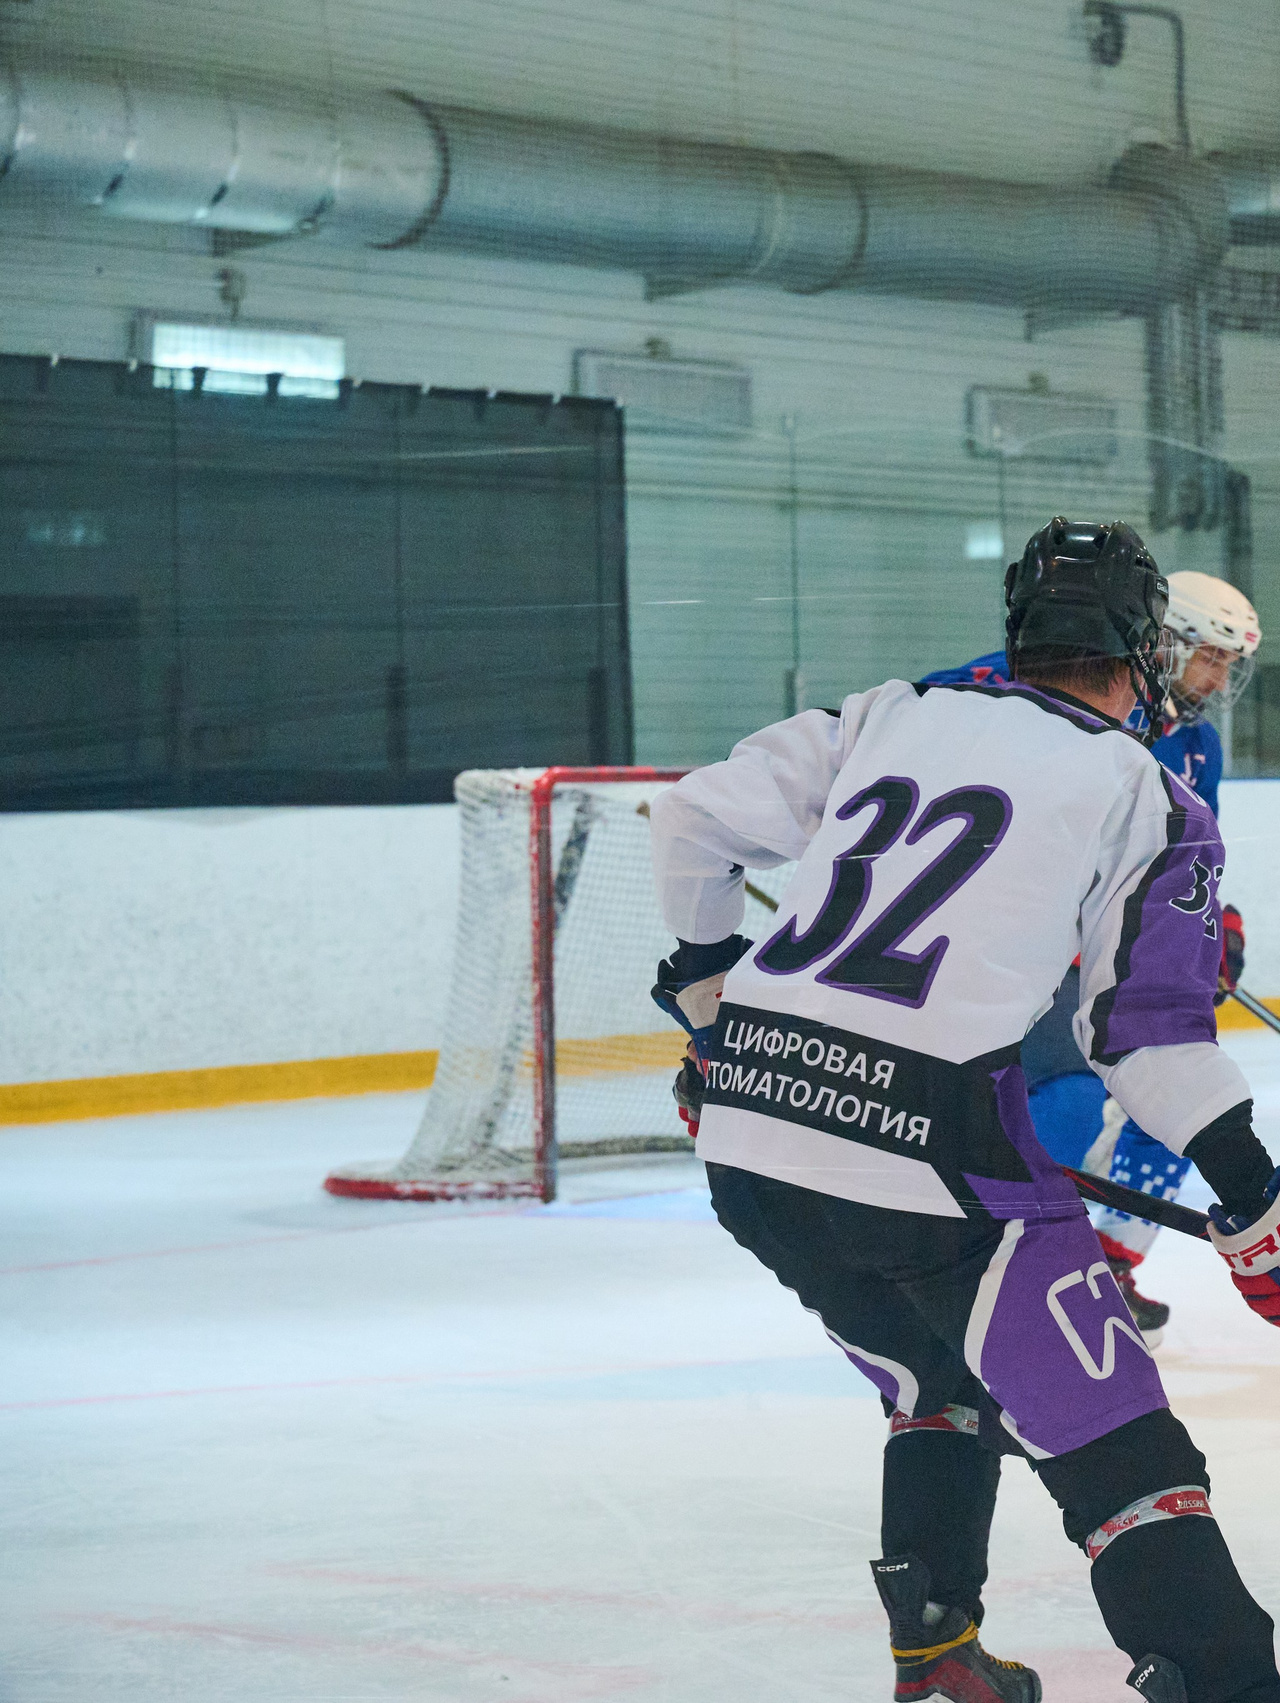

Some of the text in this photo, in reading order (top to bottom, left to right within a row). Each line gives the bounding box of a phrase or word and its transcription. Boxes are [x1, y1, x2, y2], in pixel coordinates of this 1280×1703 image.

[753, 775, 1014, 1010] 32
[723, 1019, 896, 1090] ЦИФРОВАЯ
[876, 1562, 909, 1572] CCM
[1134, 1663, 1155, 1689] CCM
